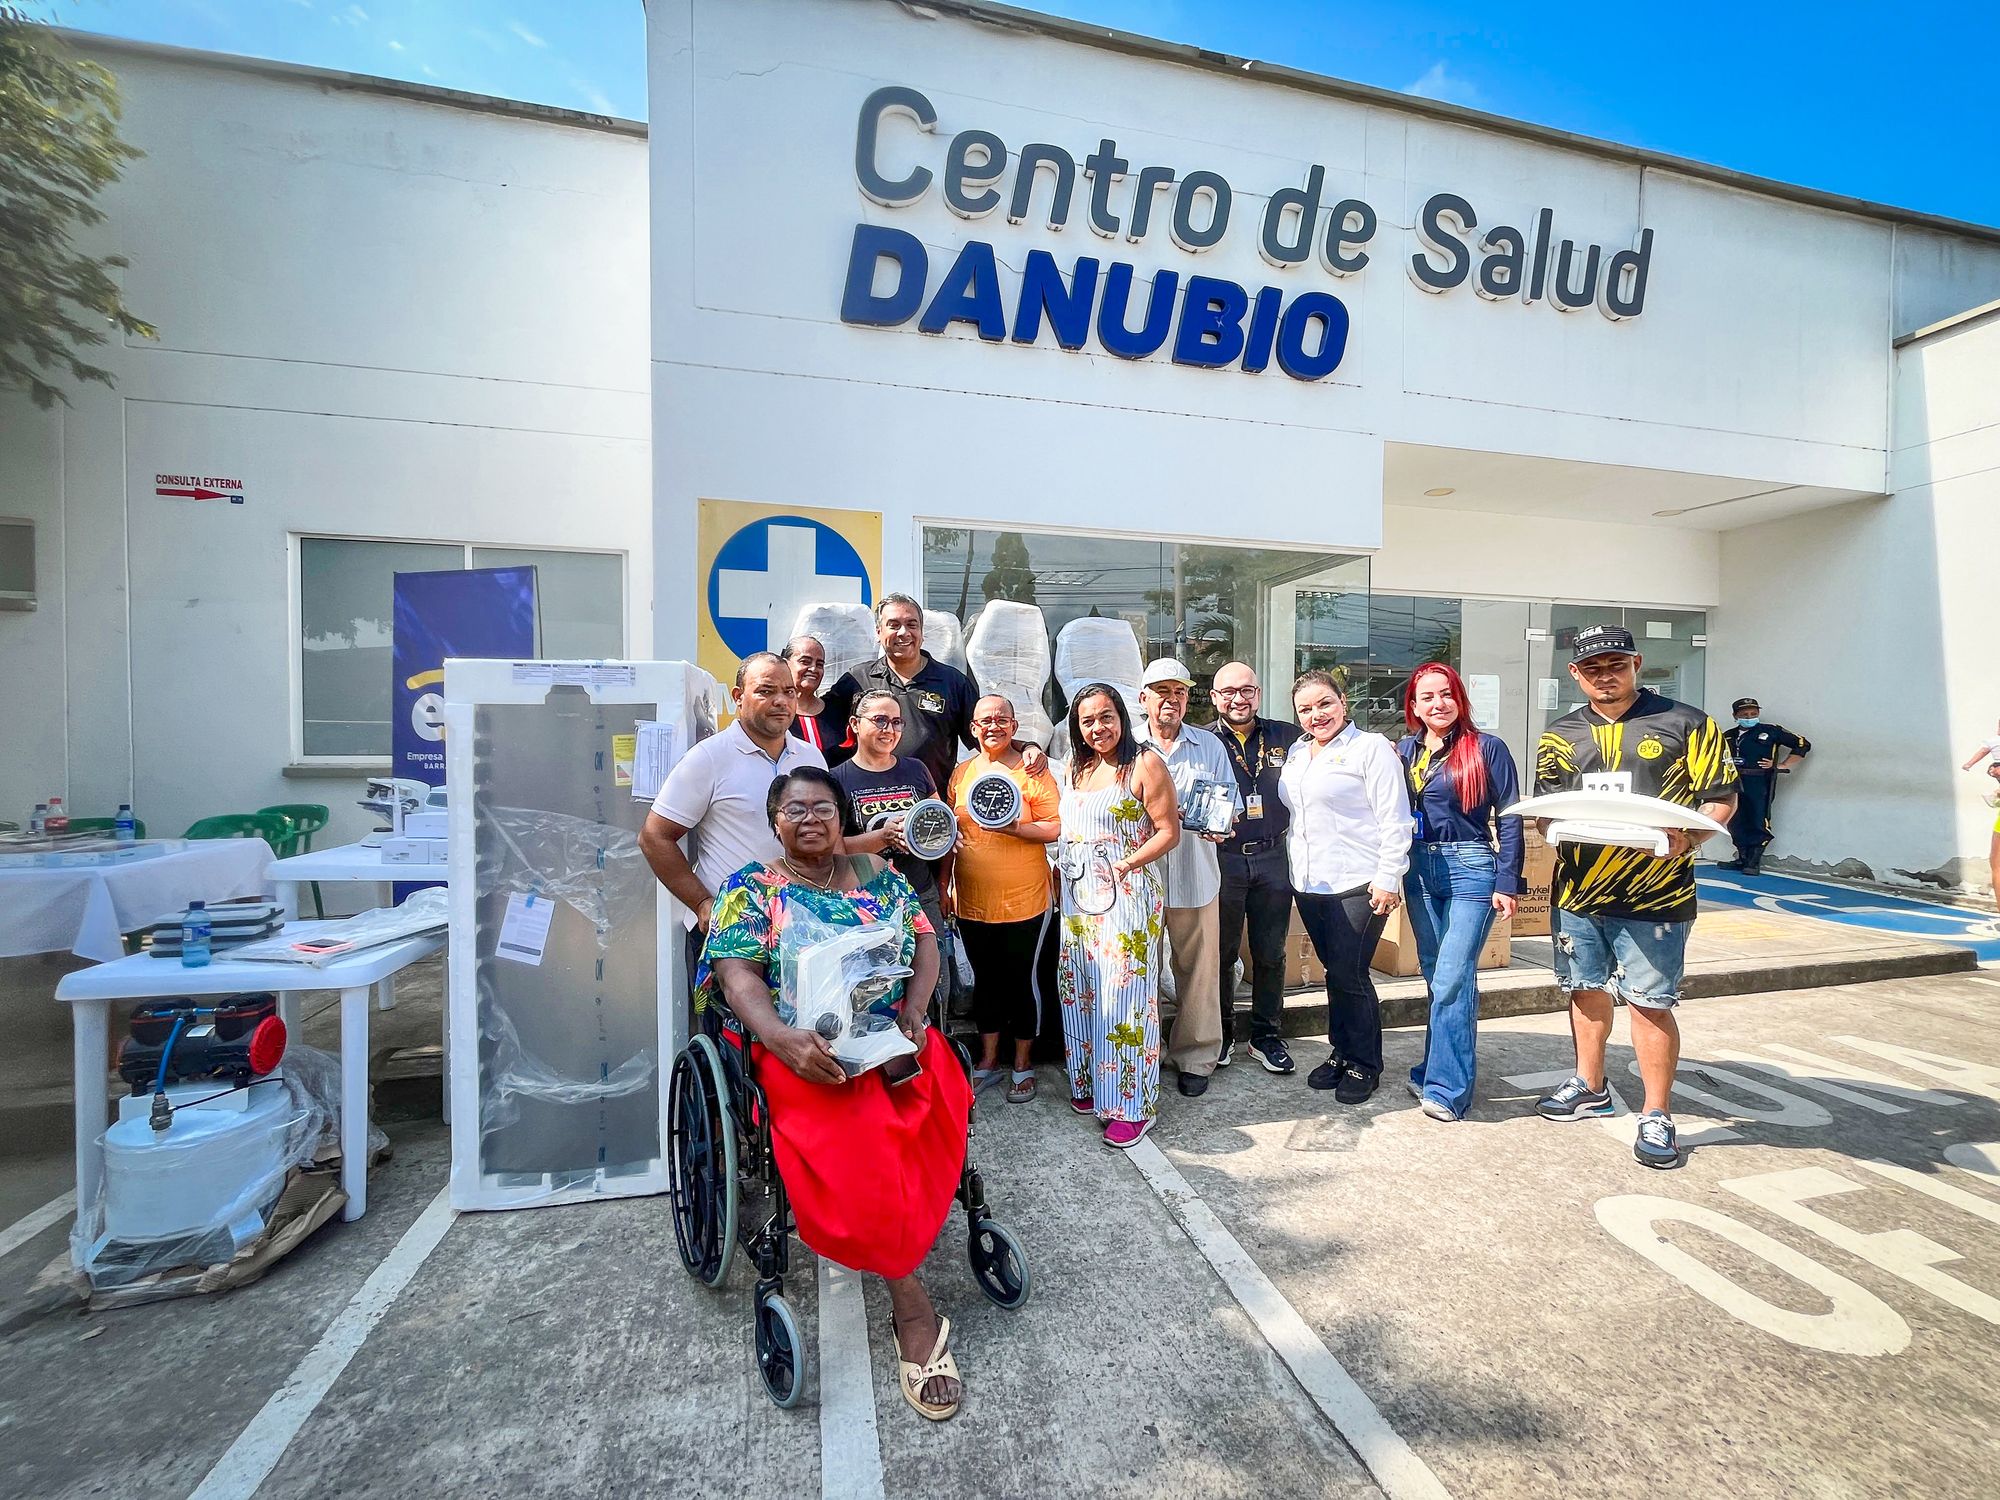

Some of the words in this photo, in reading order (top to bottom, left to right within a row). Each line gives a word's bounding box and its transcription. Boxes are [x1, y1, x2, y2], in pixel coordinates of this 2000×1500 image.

[854, 86, 1232, 256] Centro
[1257, 164, 1378, 279] de
[1405, 193, 1655, 323] Salud
[840, 223, 1350, 382] DANUBIO
[156, 474, 201, 486] CONSULTA
[203, 477, 243, 489] EXTERNA
[1639, 742, 1660, 754] BVB
[407, 752, 444, 762] Empresa
